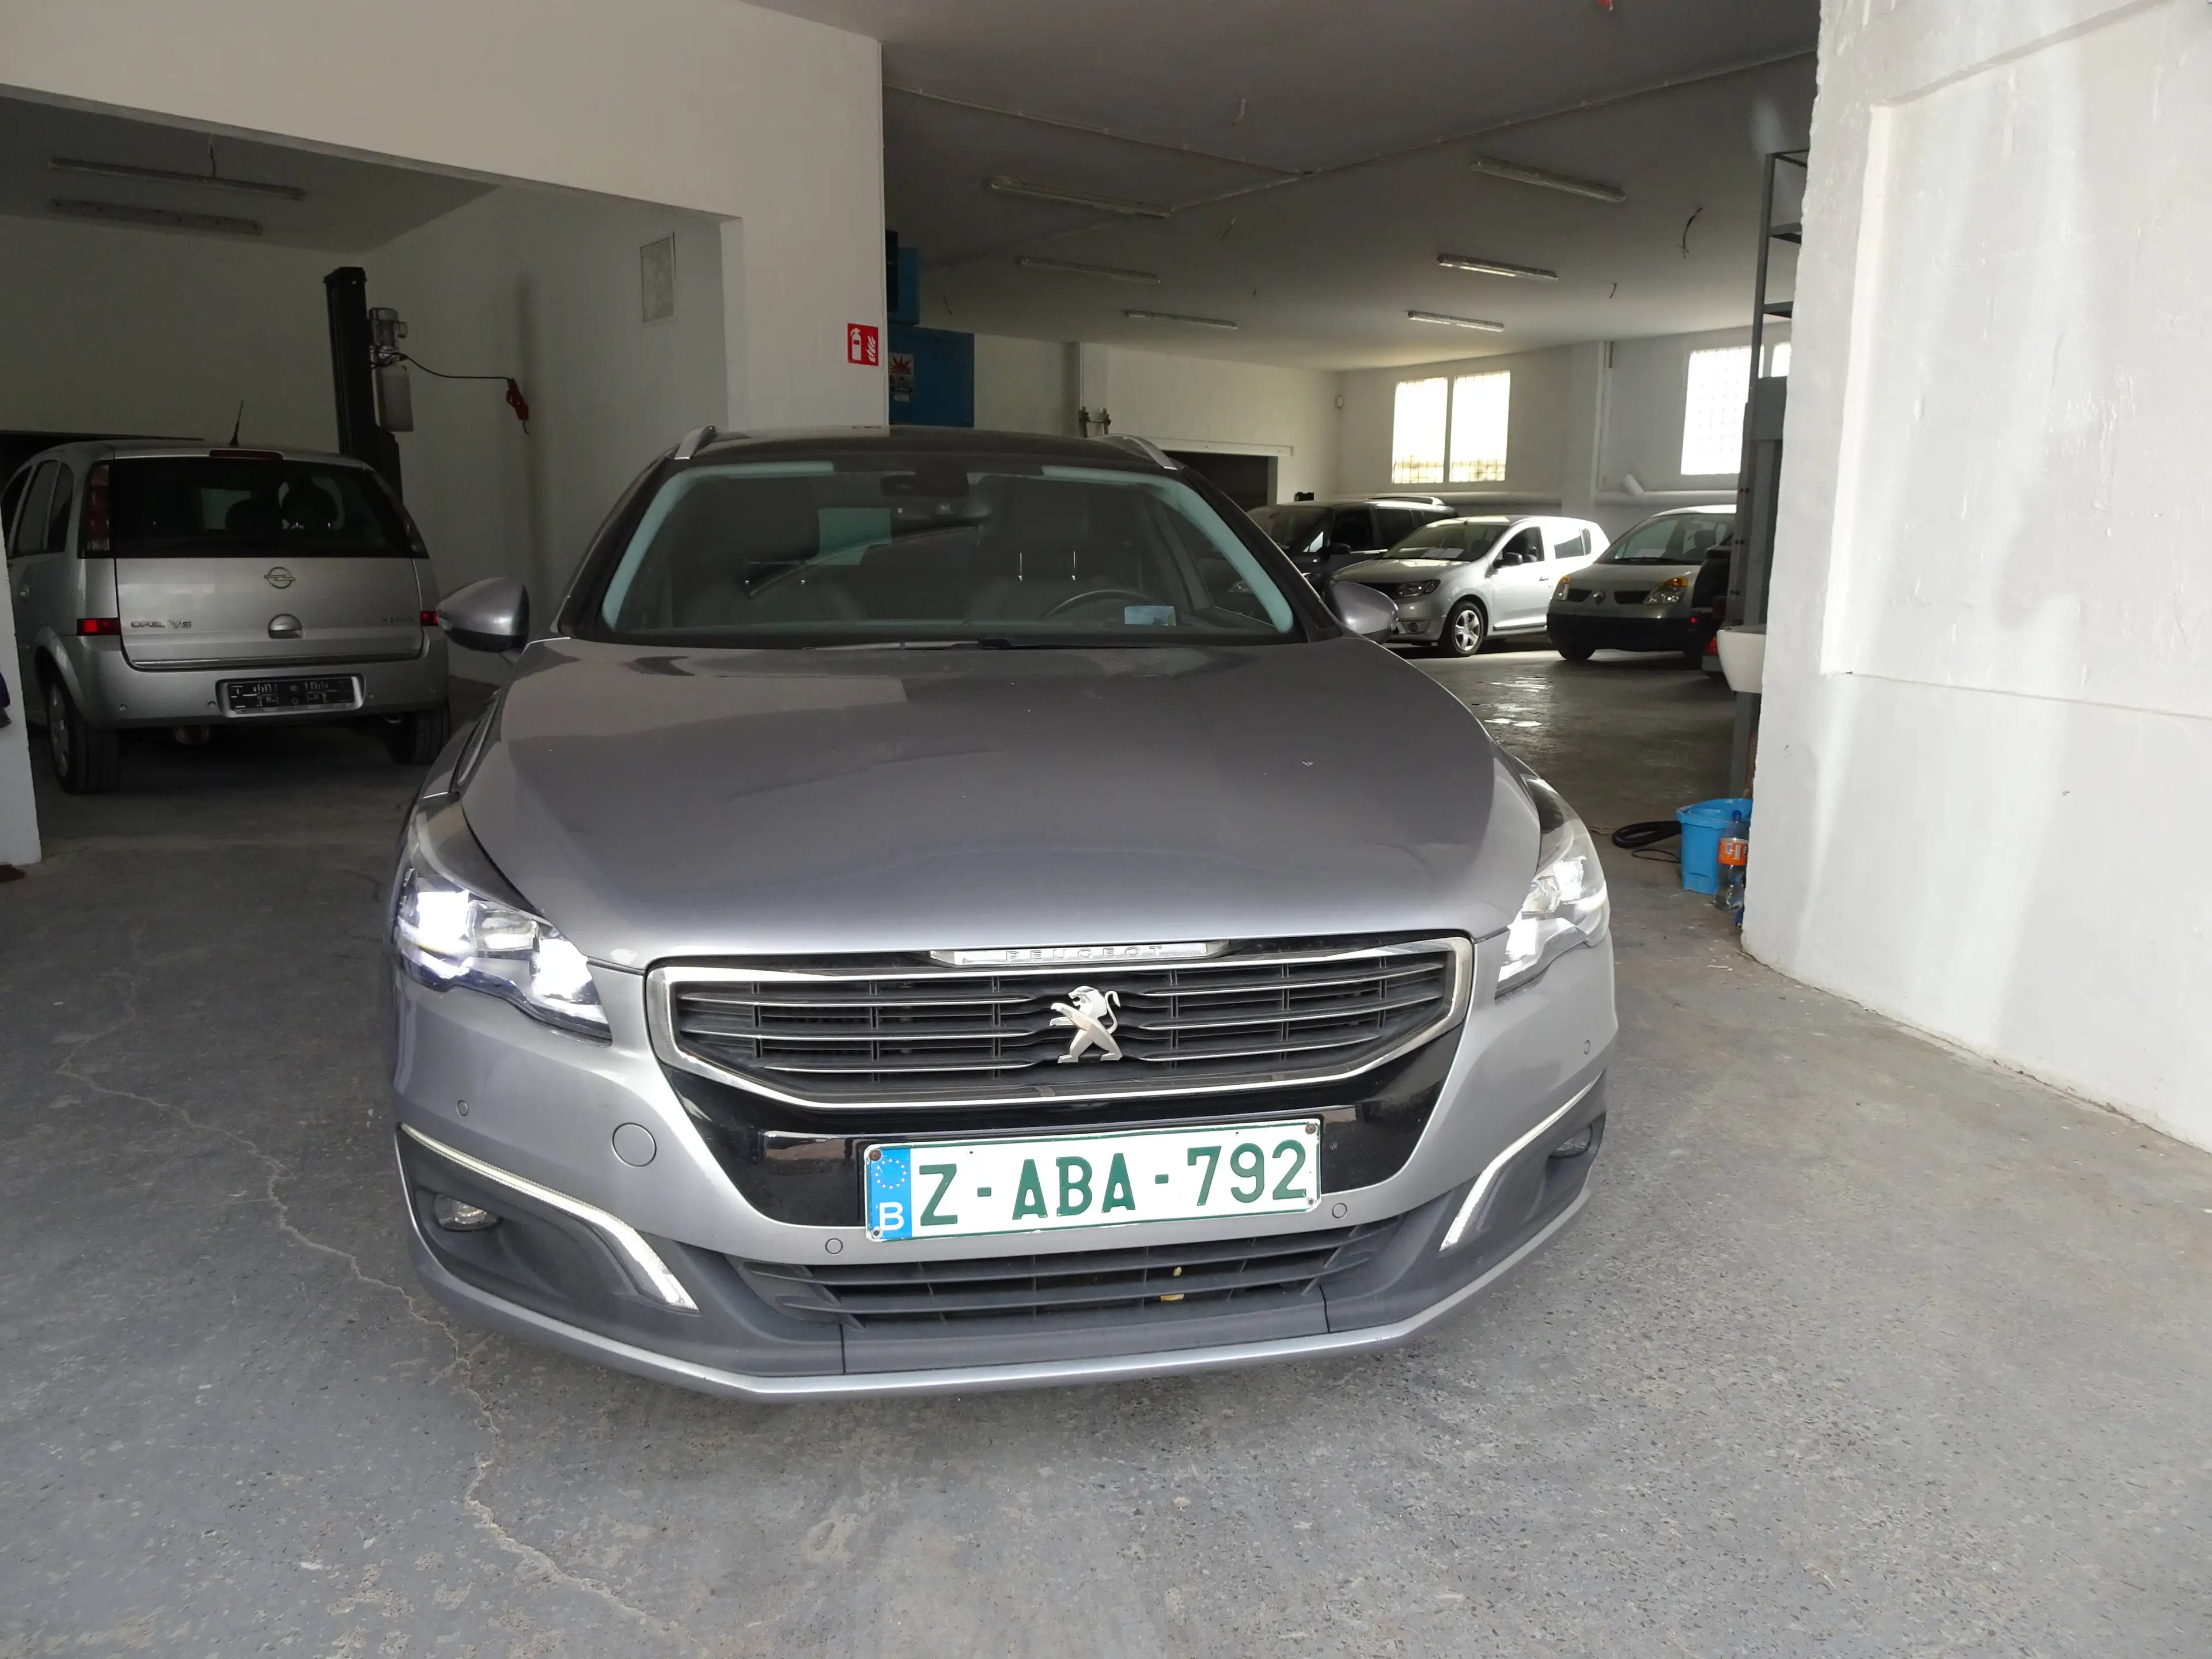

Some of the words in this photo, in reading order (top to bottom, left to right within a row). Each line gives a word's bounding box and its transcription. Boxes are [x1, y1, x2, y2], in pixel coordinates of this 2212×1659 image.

[1006, 945, 1162, 961] PEUGEOT
[919, 1139, 1307, 1226] Z-ABA-792
[879, 1202, 904, 1231] B
